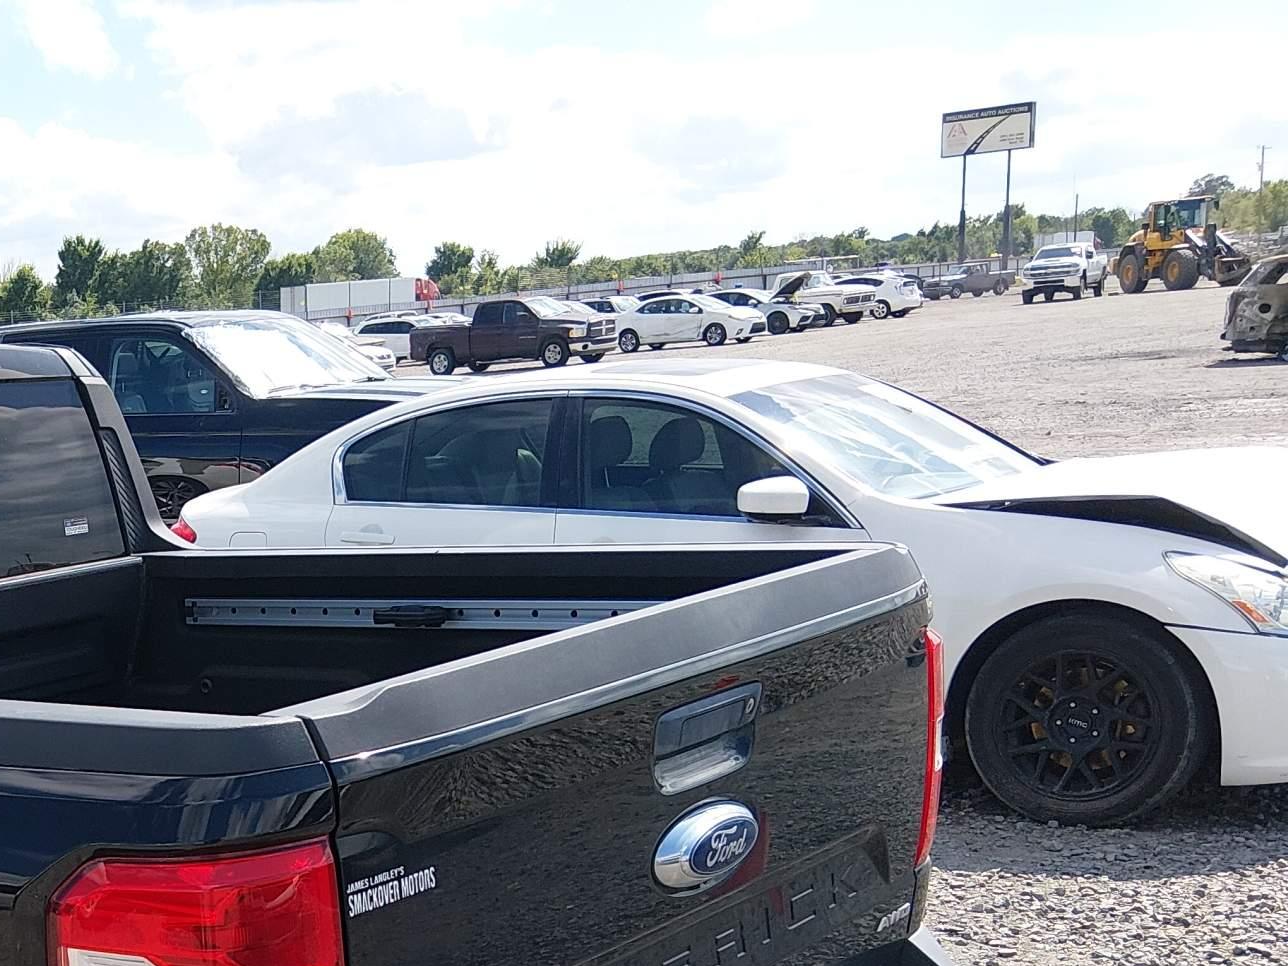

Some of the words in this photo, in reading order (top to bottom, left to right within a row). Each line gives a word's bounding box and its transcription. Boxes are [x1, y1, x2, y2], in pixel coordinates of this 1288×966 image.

[945, 112, 979, 122] INSURANCE
[998, 105, 1028, 116] AUCTIONS
[706, 824, 747, 867] Ford
[346, 878, 369, 894] JAMES
[370, 866, 405, 886] LANGLEY'S
[348, 880, 401, 918] SMACKOVER
[401, 866, 436, 899] MOTORS
[876, 902, 911, 933] AWD
